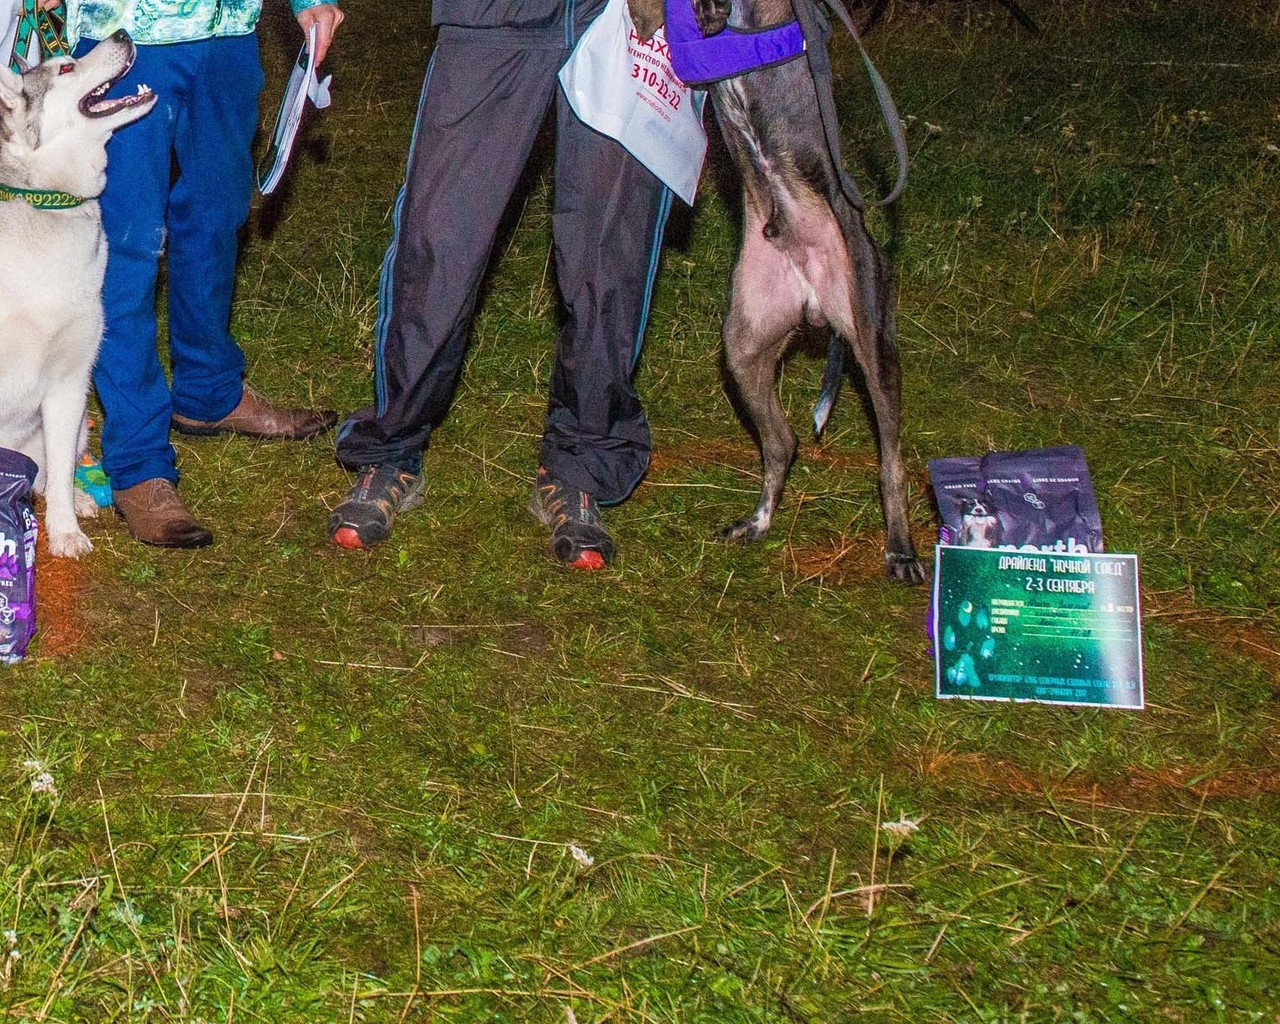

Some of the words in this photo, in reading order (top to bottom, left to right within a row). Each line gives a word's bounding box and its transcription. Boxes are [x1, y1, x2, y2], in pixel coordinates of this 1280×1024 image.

[998, 556, 1047, 573] ДРАЙЛЕНД
[1025, 577, 1044, 591] 2-3
[1047, 578, 1095, 594] СЕНТЯБРЯ
